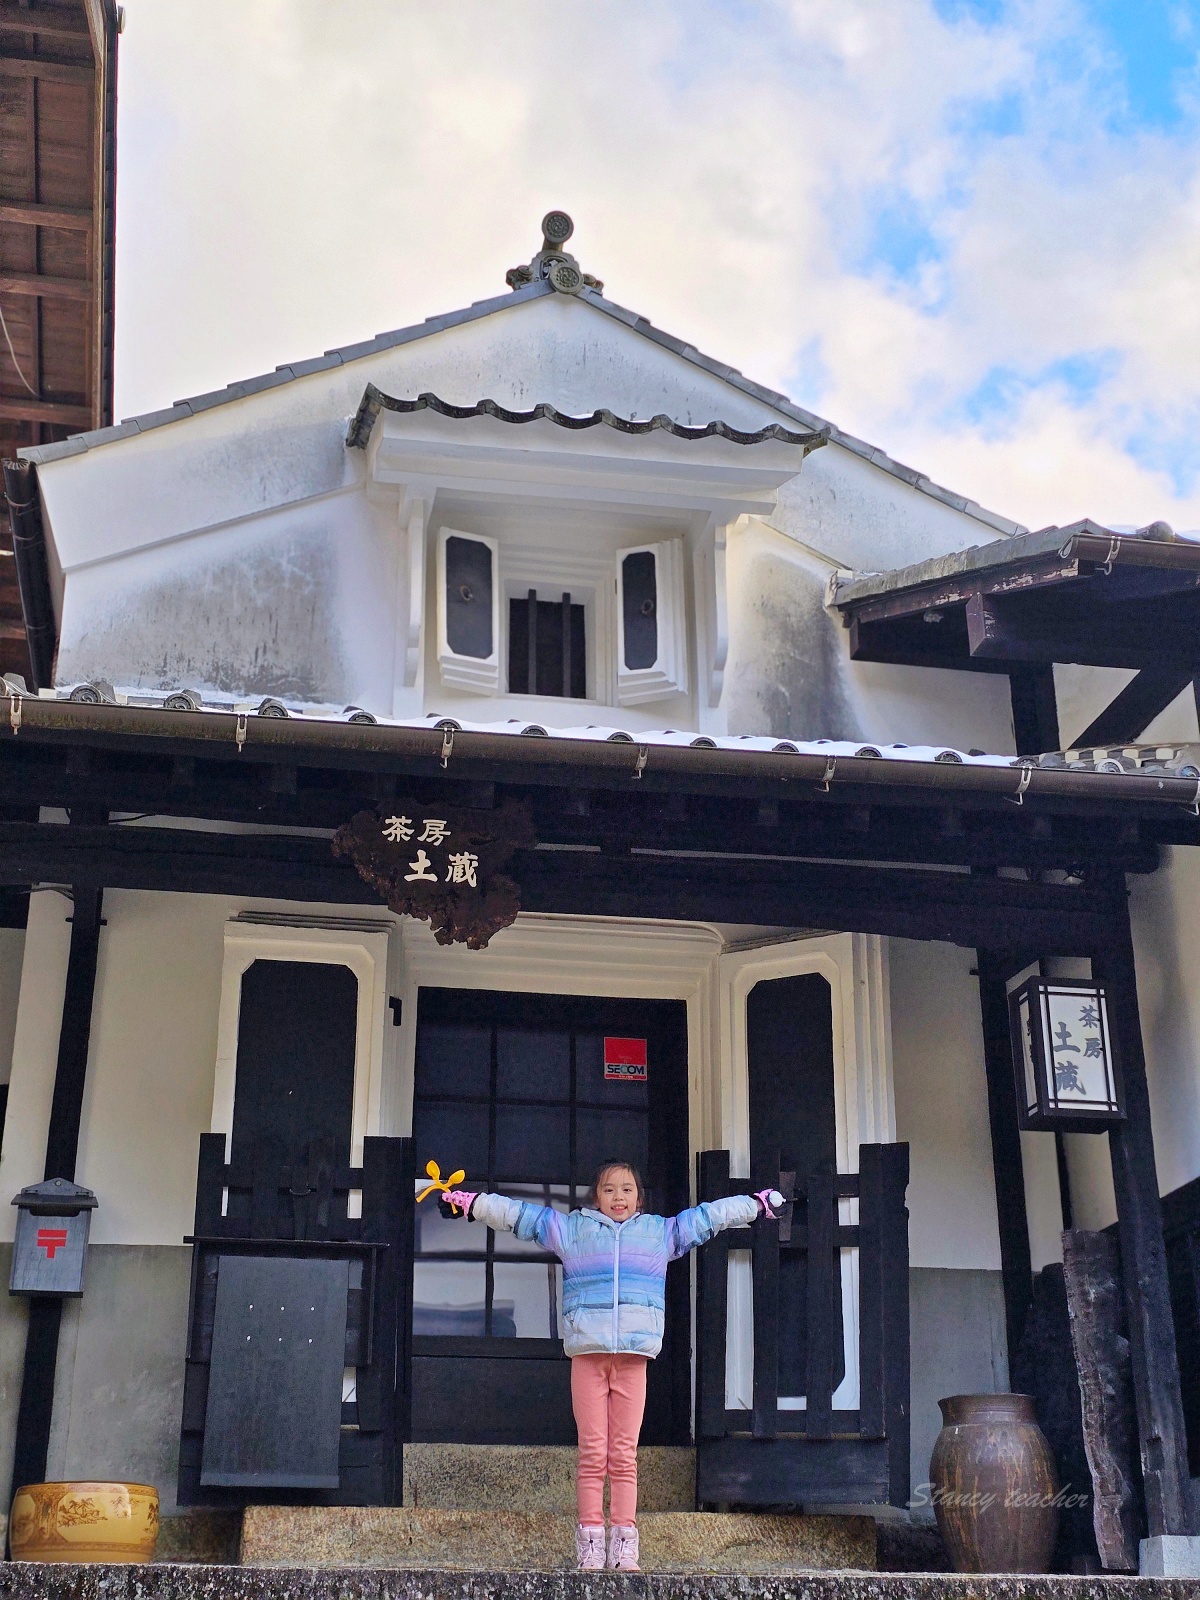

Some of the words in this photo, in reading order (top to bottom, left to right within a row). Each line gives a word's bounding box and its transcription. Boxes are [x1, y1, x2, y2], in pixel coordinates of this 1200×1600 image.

[382, 816, 451, 846] 茶房
[404, 850, 478, 887] 土蔵
[1078, 1004, 1101, 1059] 茶房
[607, 1064, 644, 1074] SECOM
[1053, 1022, 1086, 1095] 土蔵
